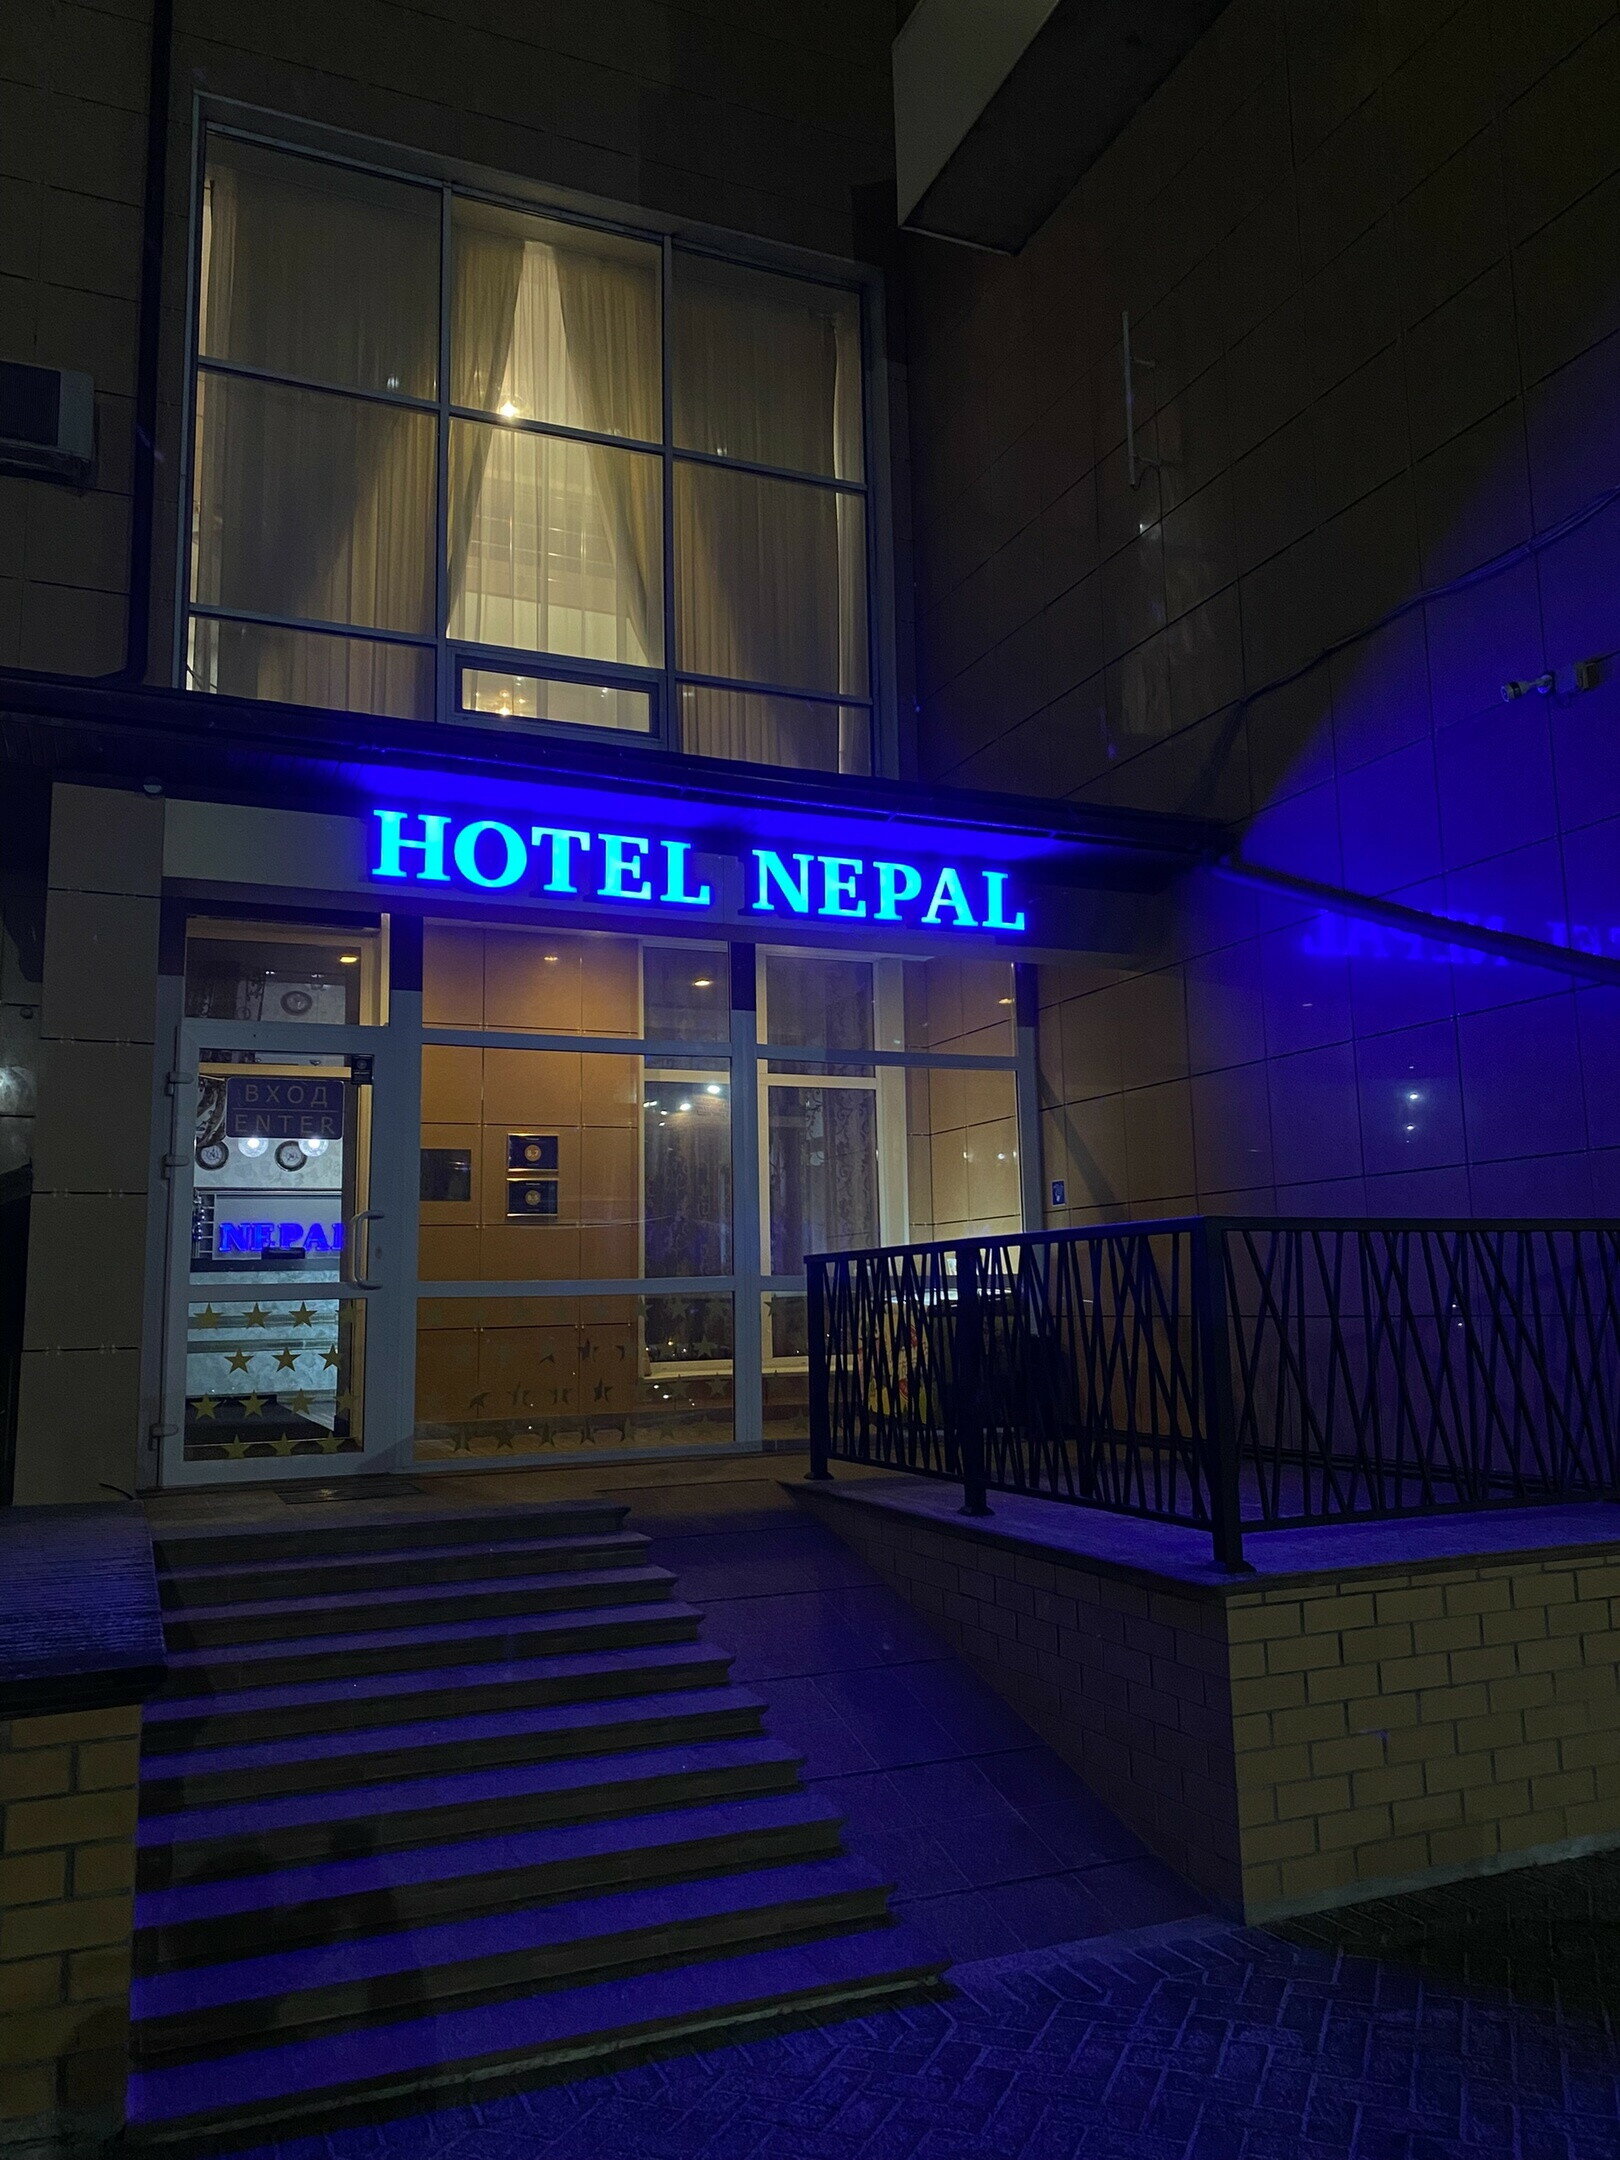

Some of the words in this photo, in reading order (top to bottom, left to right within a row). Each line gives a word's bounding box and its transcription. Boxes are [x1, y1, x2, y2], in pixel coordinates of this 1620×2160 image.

[372, 809, 710, 905] HOTEL
[752, 849, 1025, 931] NEPAL
[245, 1084, 328, 1108] ВХОД
[235, 1114, 335, 1135] ENTER
